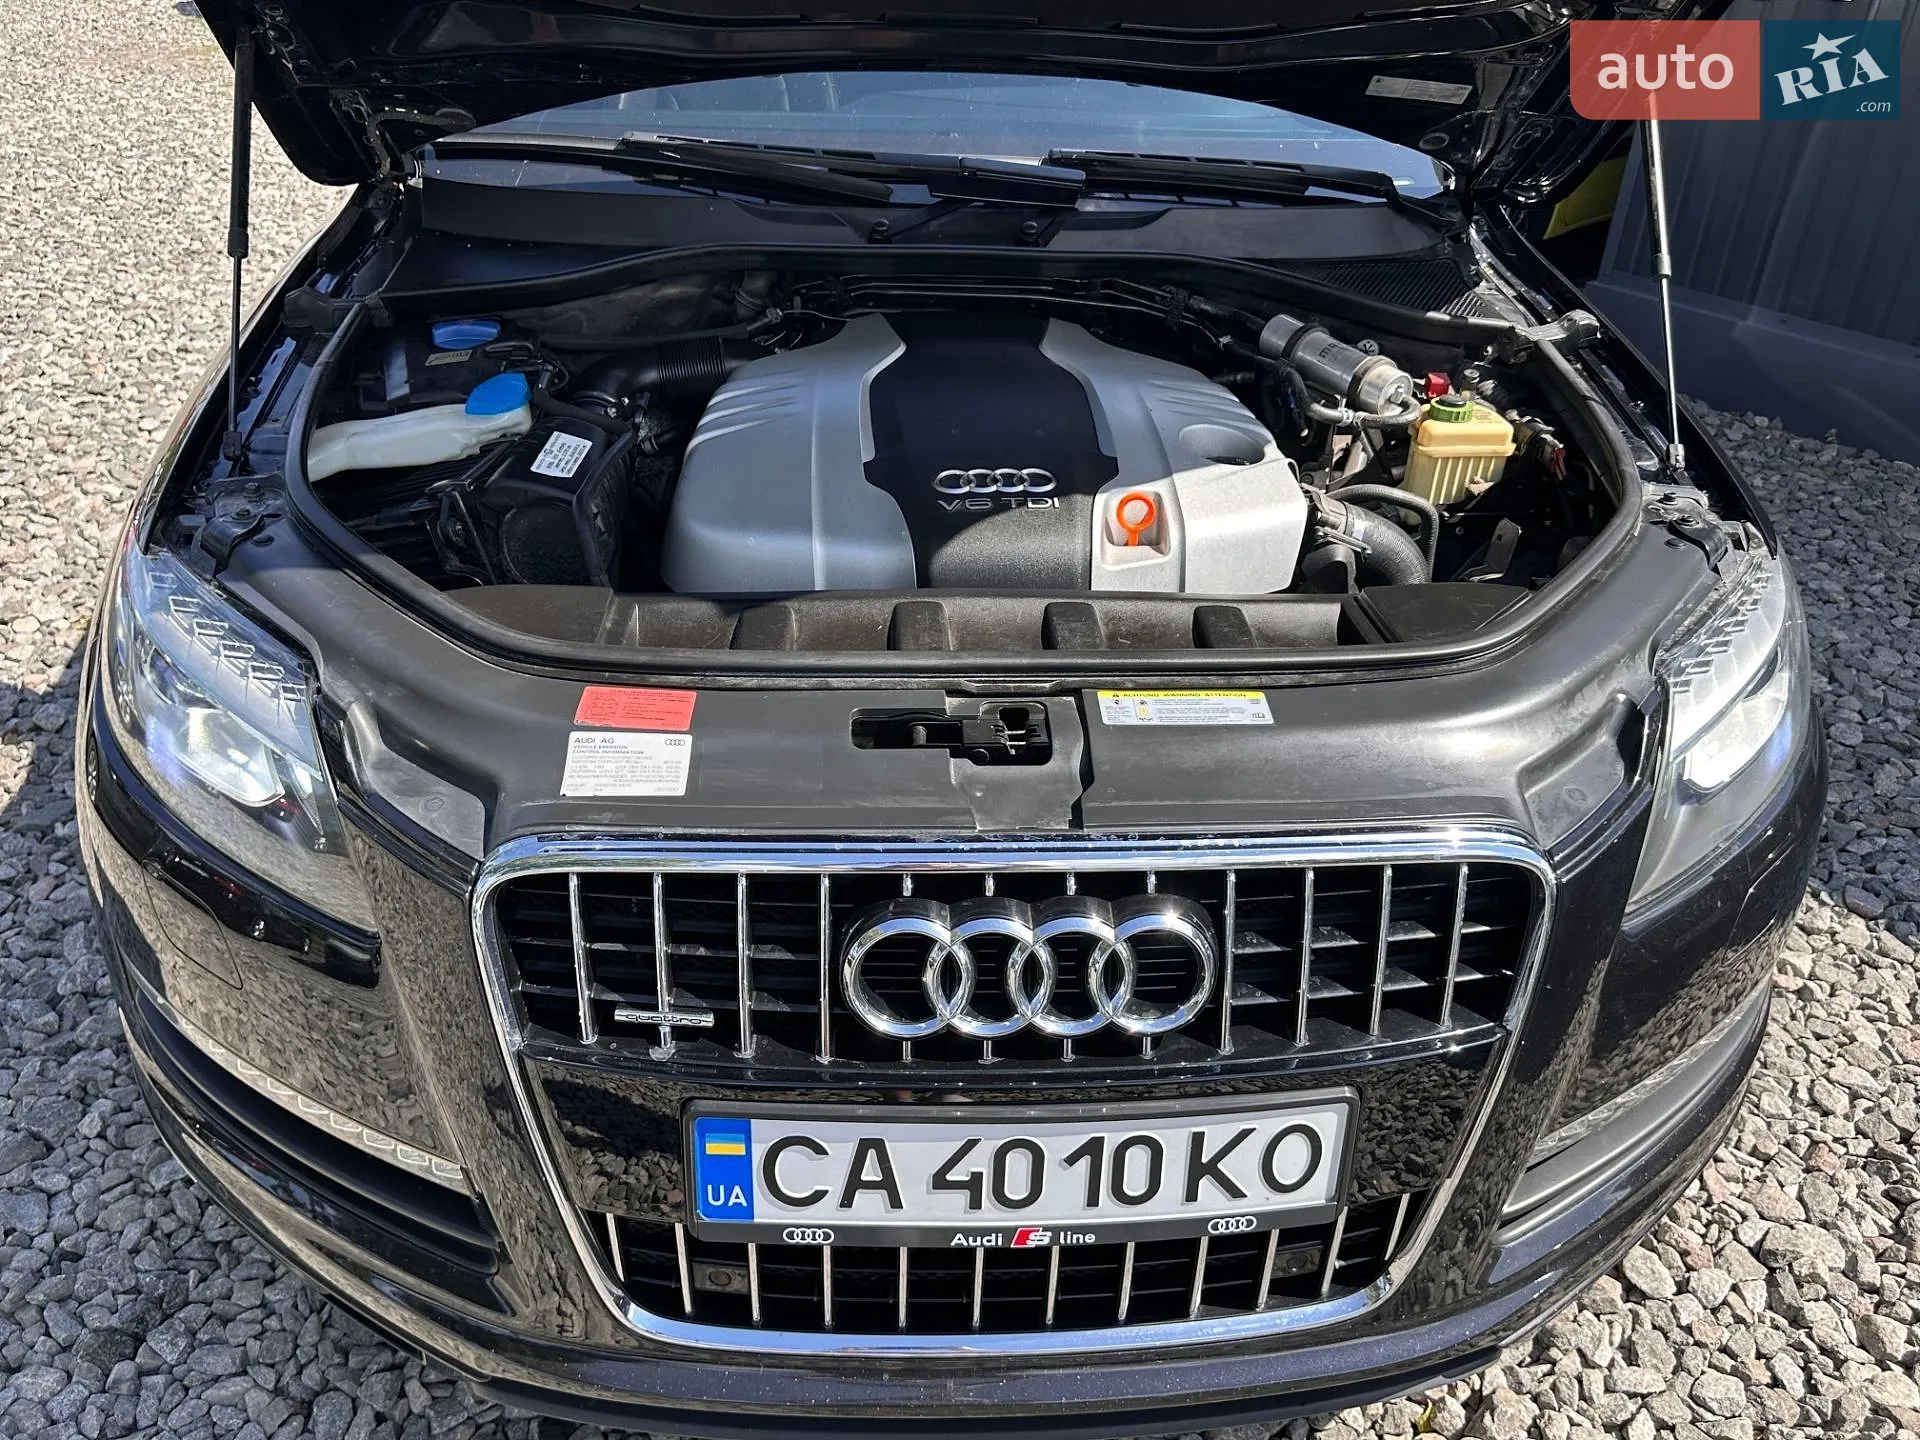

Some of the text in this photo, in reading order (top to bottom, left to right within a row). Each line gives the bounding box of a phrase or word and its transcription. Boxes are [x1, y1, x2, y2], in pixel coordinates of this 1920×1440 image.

[937, 497, 1060, 511] V6 TDI
[626, 1014, 702, 1024] quattro
[761, 1122, 1324, 1211] CA 4010 KO
[706, 1184, 748, 1208] UA
[950, 1232, 1003, 1247] Audi
[1059, 1230, 1096, 1245] line
